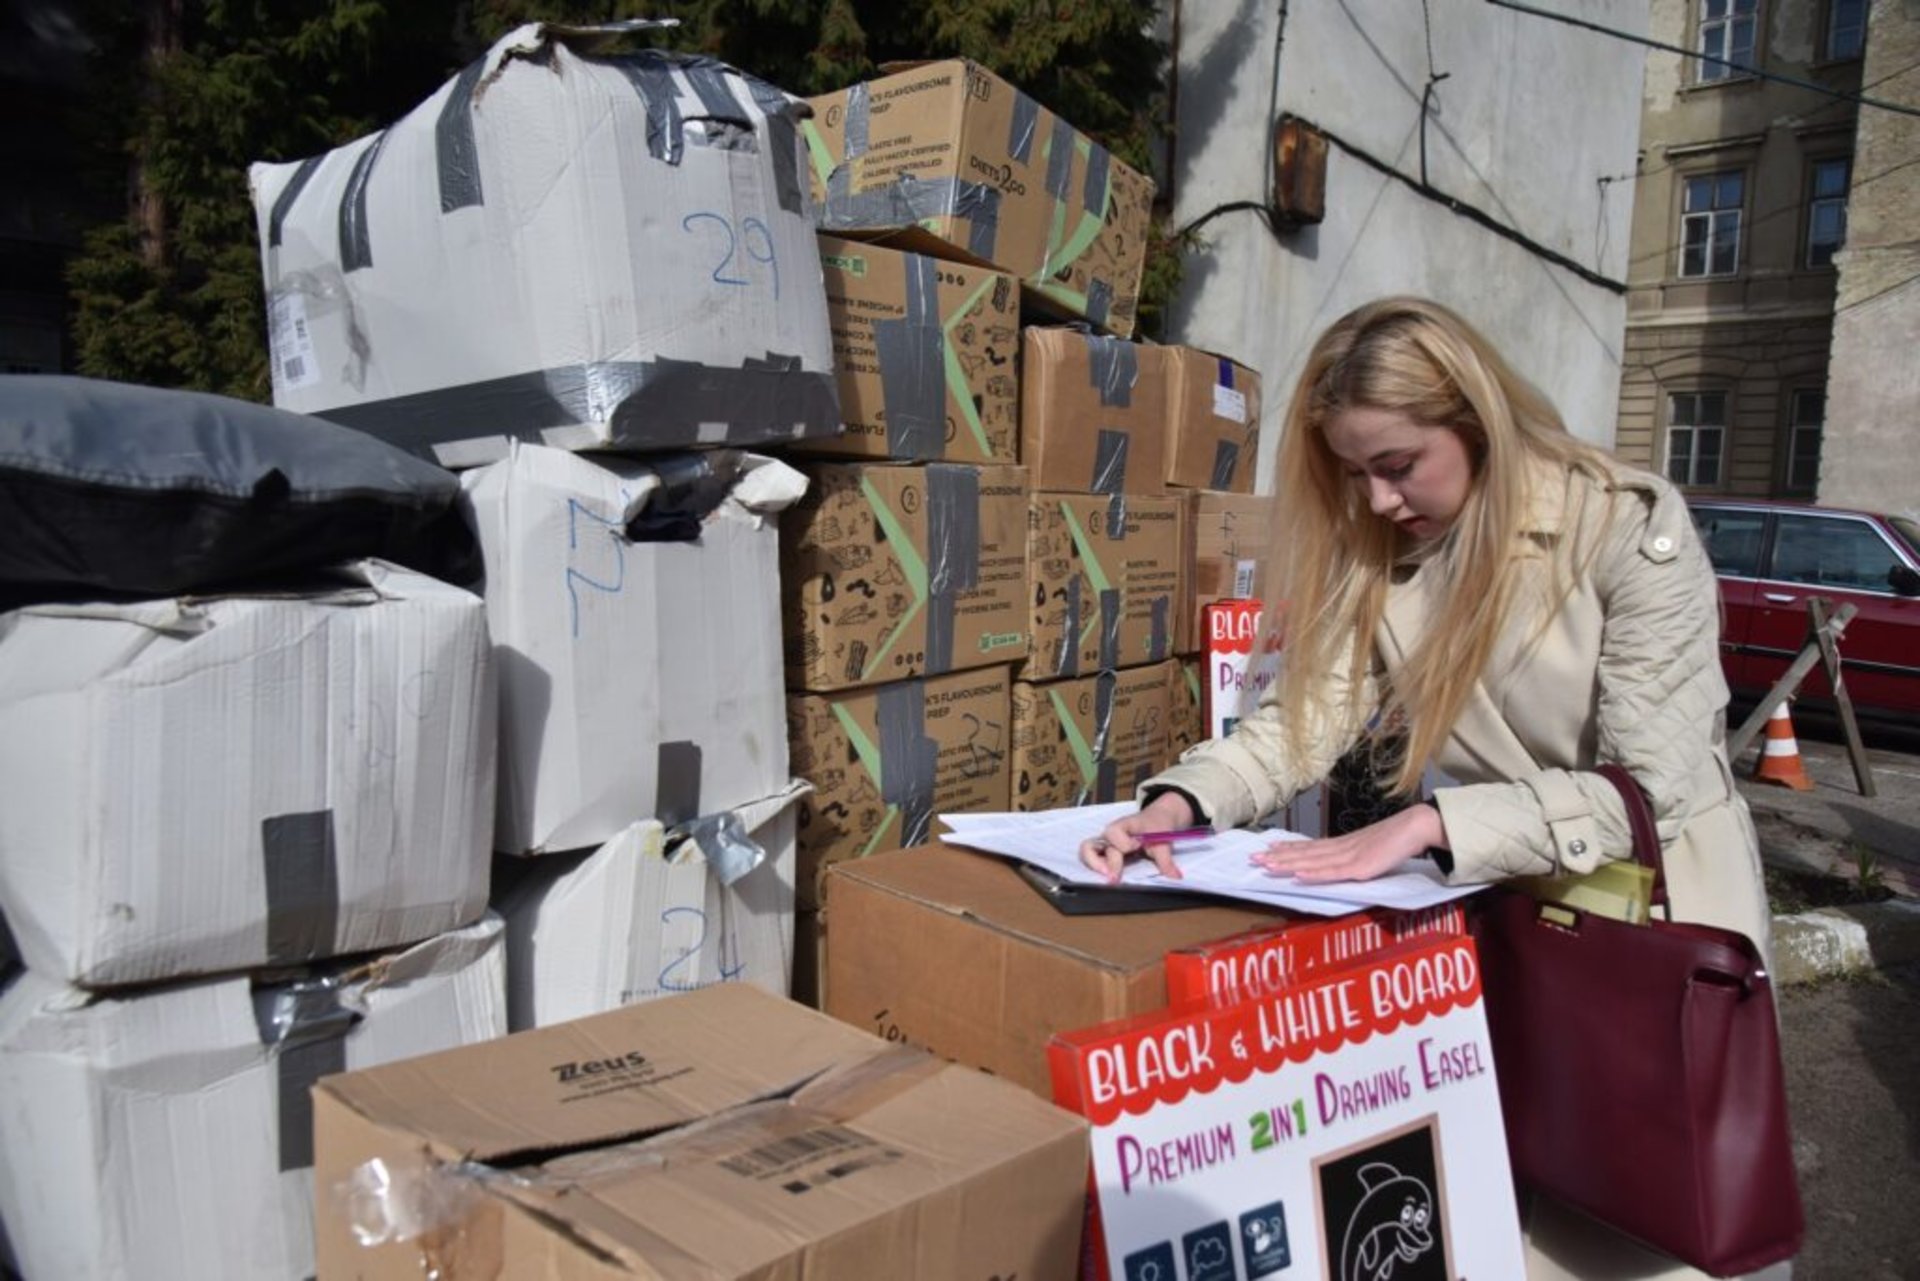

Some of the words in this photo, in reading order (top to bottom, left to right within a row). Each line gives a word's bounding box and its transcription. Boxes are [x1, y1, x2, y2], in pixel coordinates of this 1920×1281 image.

[682, 212, 780, 301] 29
[551, 1050, 646, 1083] Zeus
[1088, 1020, 1215, 1104] BLACK
[1231, 1030, 1248, 1060] &
[1257, 980, 1362, 1053] WHITE
[1369, 946, 1476, 1018] BOARD
[1116, 1121, 1236, 1195] PREMIUM
[1248, 1098, 1306, 1152] 2IN1
[1314, 1064, 1411, 1127] DRAWING
[1418, 1037, 1486, 1091] EASEL
